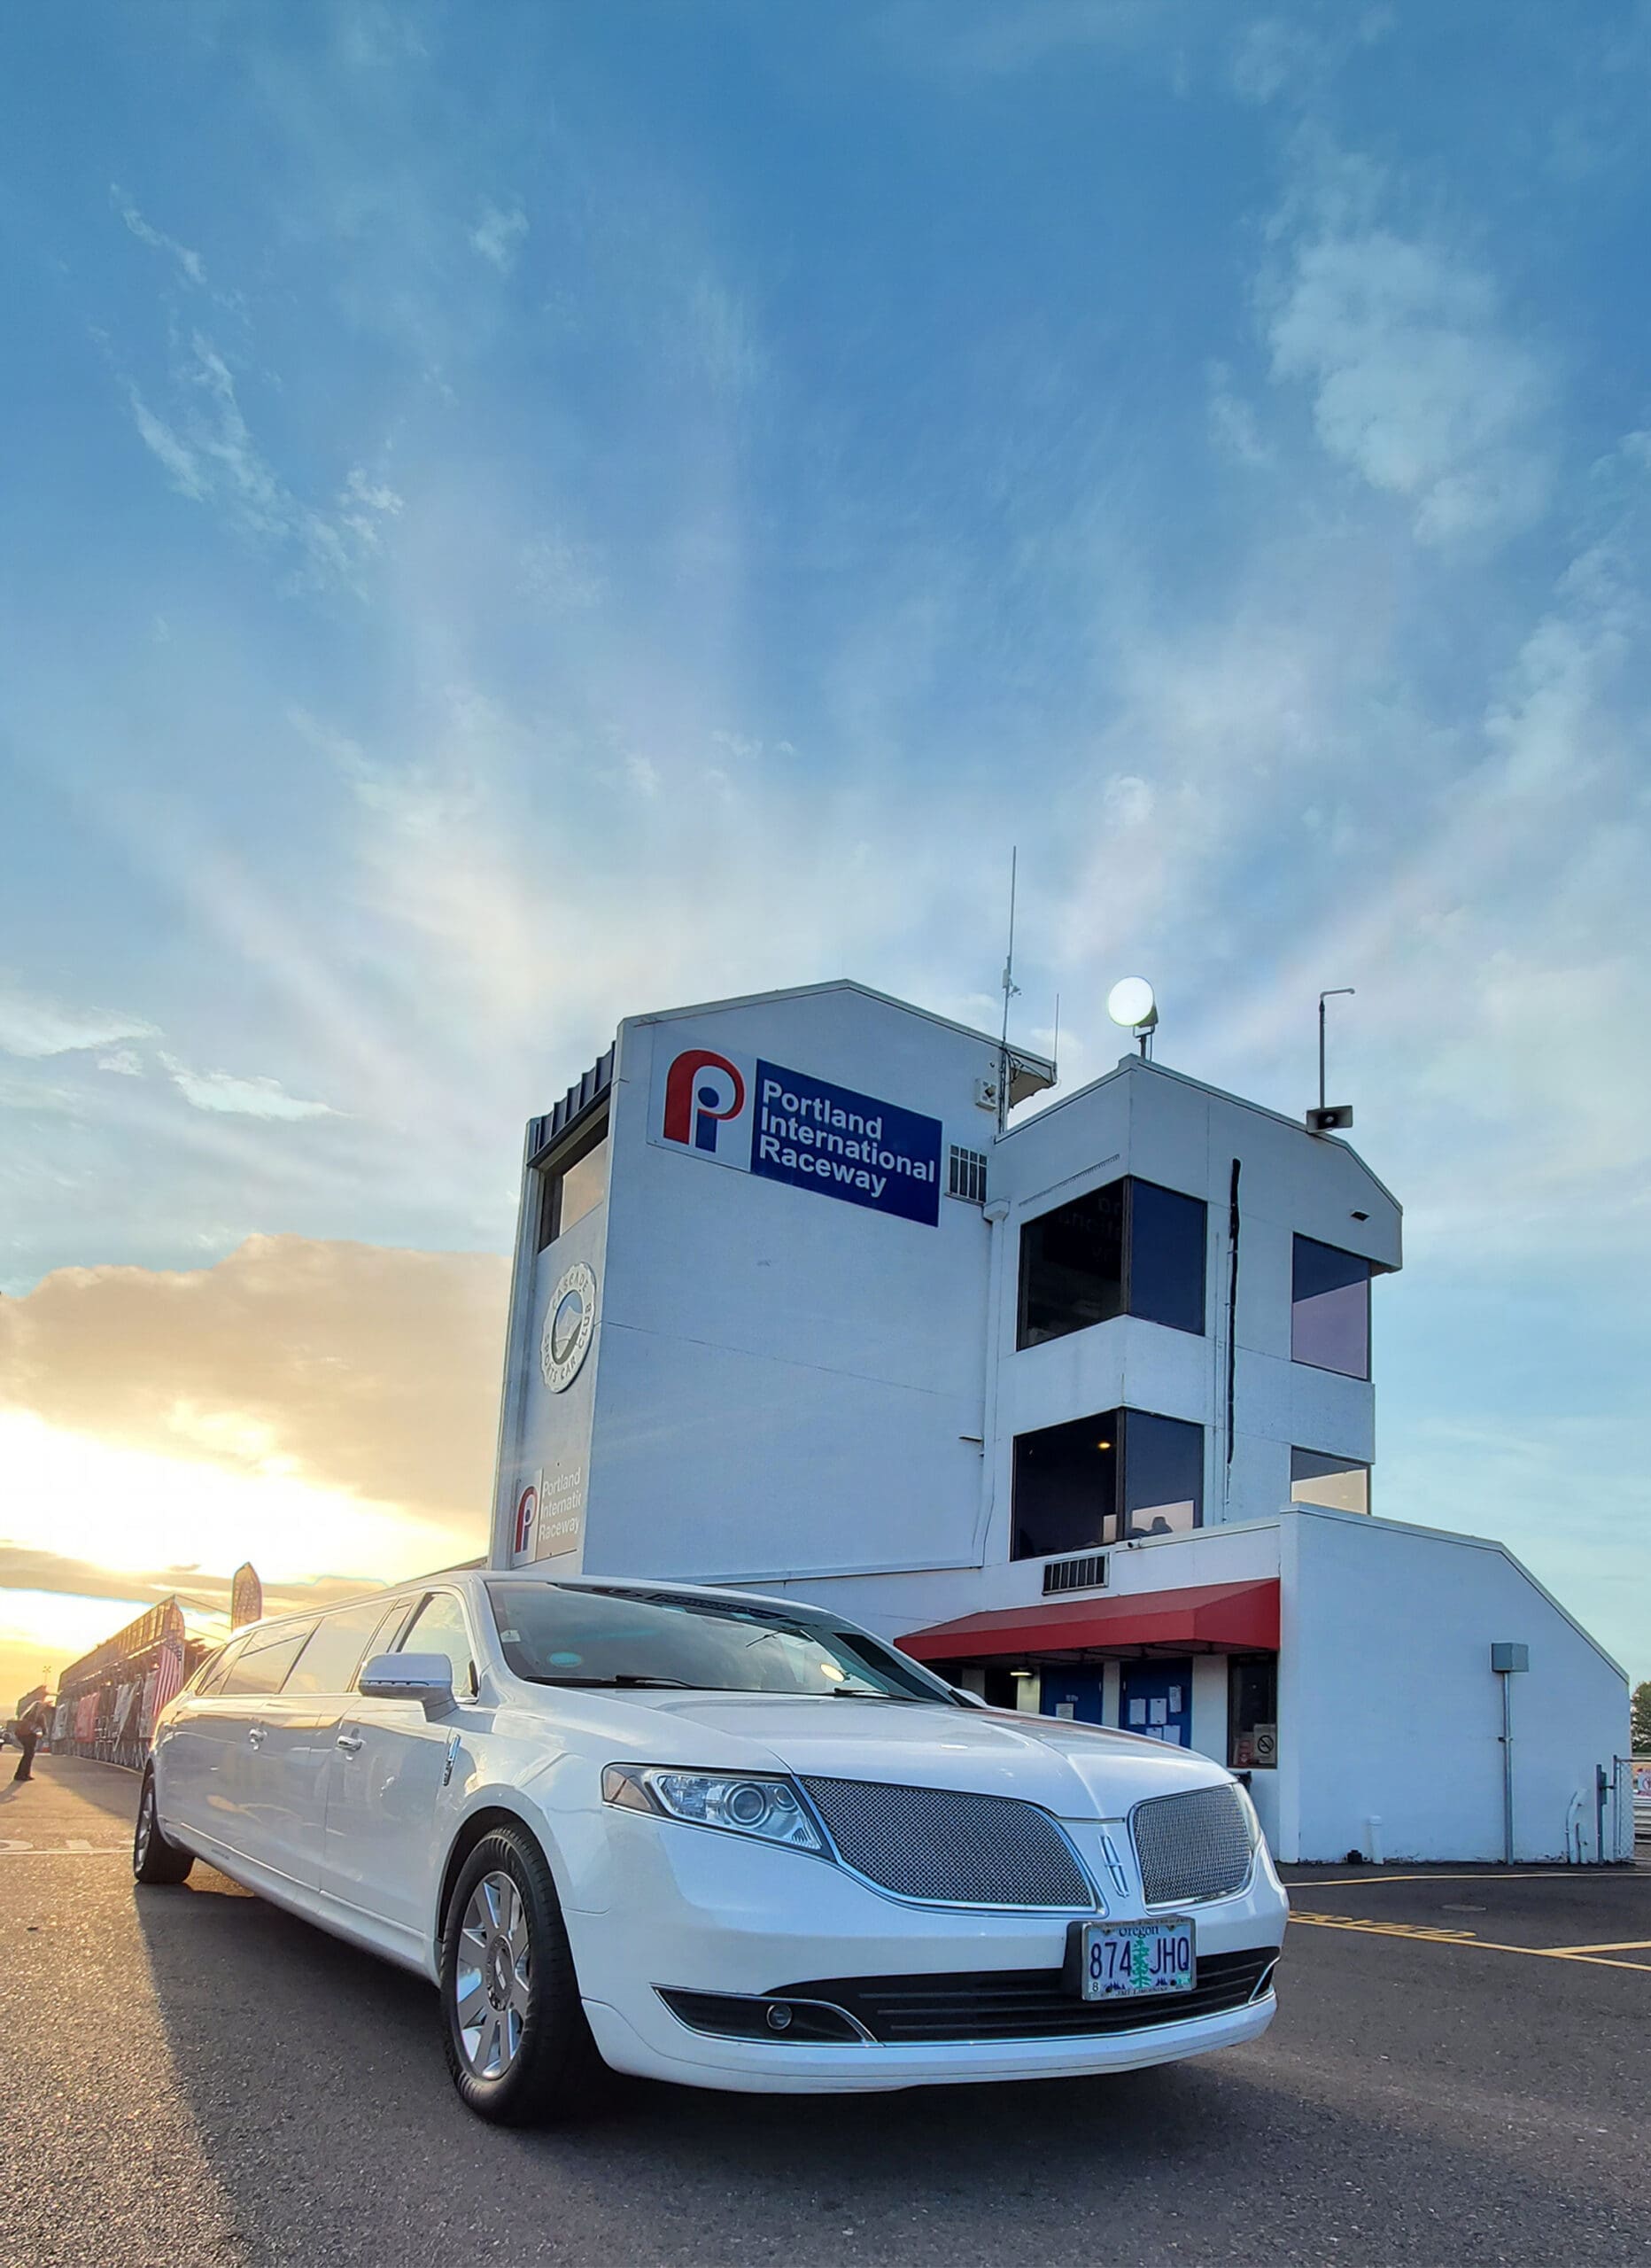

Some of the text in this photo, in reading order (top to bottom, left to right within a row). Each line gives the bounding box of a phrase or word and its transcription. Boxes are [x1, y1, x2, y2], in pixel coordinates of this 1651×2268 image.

[762, 1078, 883, 1141] Portland
[759, 1133, 888, 1199] Raceway
[760, 1106, 935, 1183] International
[577, 1302, 592, 1349] CLUB
[542, 1467, 581, 1498] Portland
[539, 1518, 580, 1542] Raceway
[1119, 1925, 1159, 1939] Oregon
[1089, 1937, 1190, 1980] 874 JHQ
